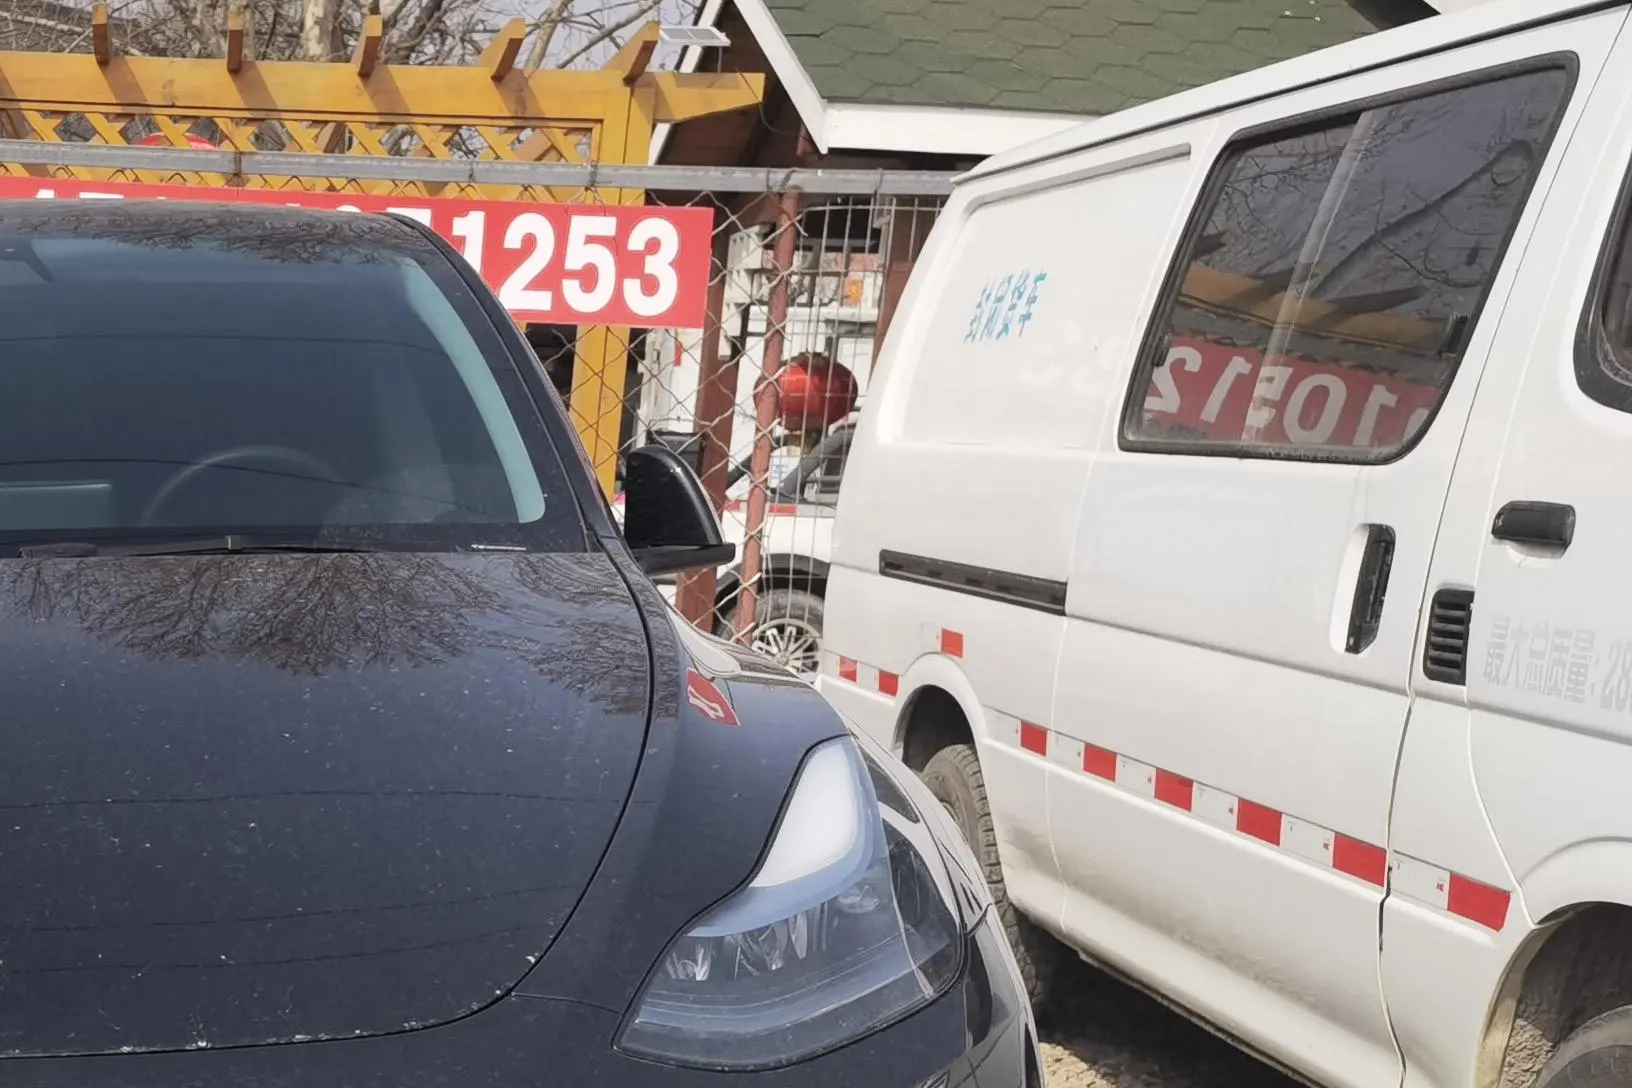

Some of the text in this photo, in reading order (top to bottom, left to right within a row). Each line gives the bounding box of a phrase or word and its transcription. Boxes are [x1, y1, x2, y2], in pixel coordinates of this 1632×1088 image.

[1482, 614, 1632, 716] 最大总质量:28
